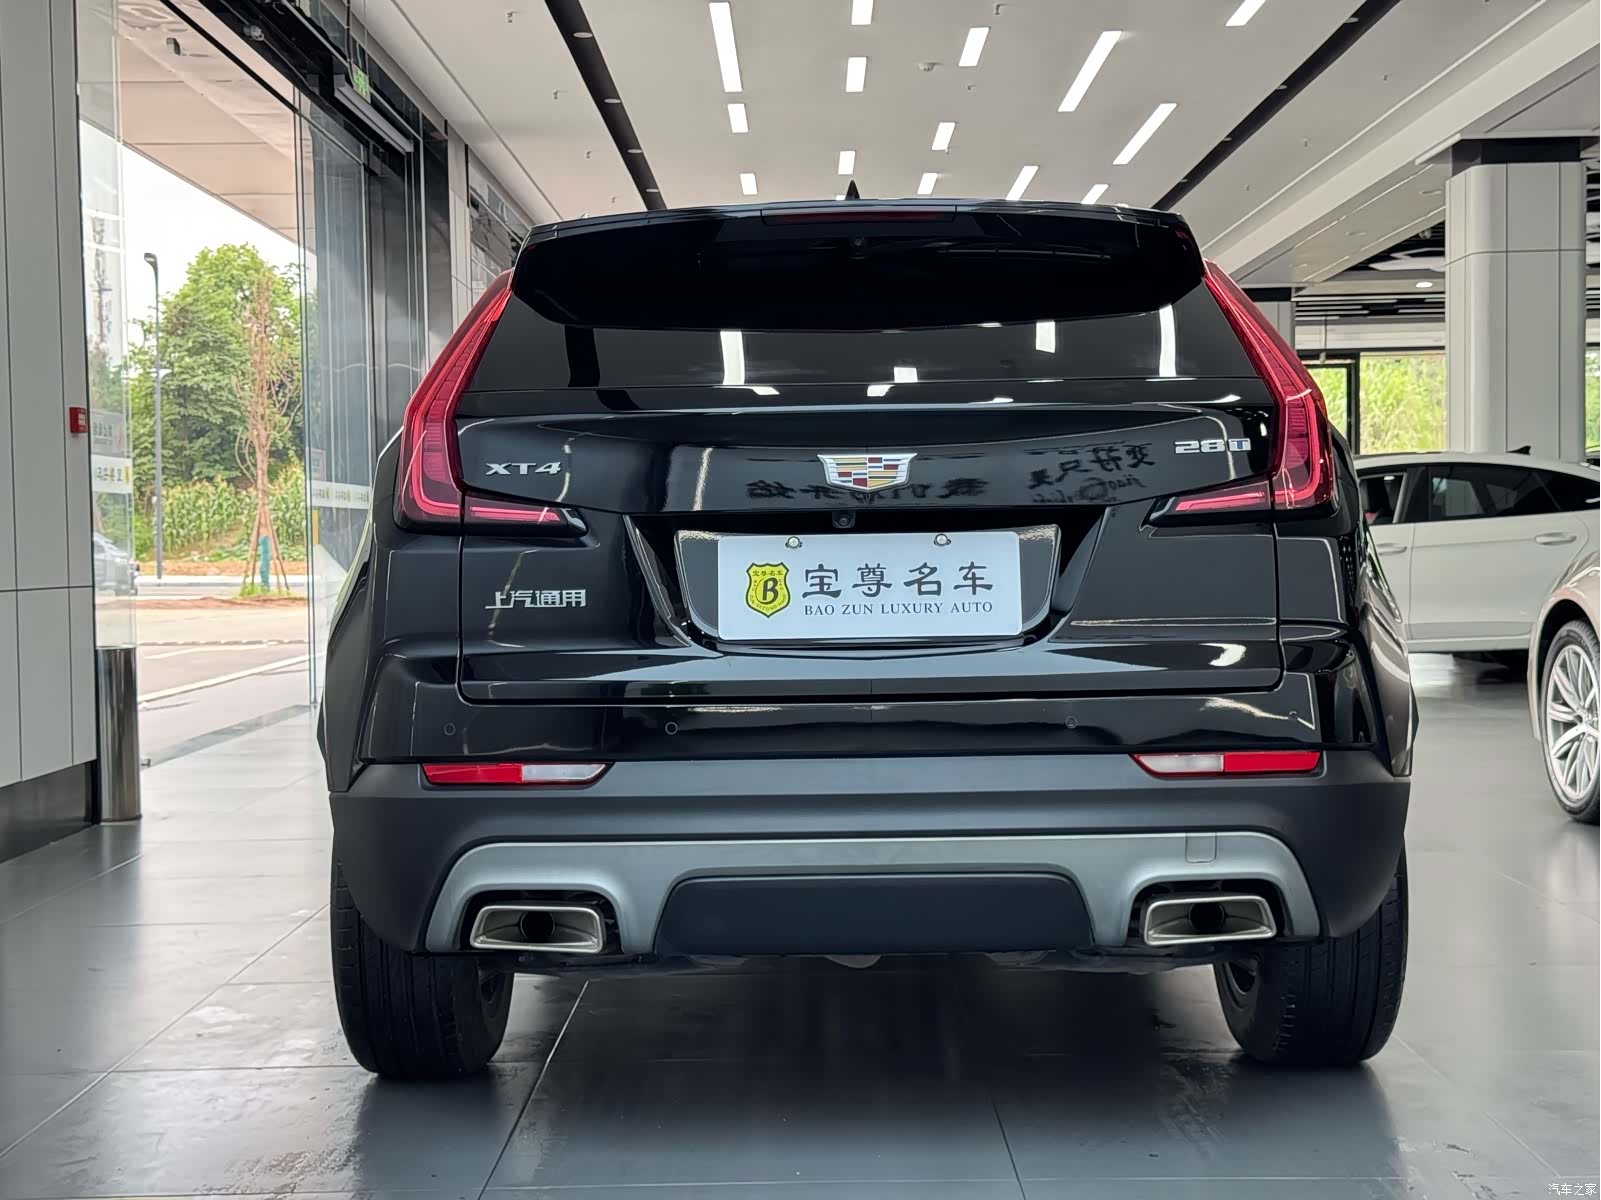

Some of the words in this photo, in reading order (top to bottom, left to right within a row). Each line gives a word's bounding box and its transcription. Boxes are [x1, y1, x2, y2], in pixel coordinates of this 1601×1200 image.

[1174, 437, 1251, 454] 28T
[485, 461, 562, 476] XT4
[801, 561, 994, 598] 宝尊名车
[485, 589, 587, 609] 上汽通用
[804, 604, 835, 616] BAO
[841, 603, 874, 615] ZUN
[881, 602, 944, 614] LUXURY
[950, 601, 993, 613] AUTO
